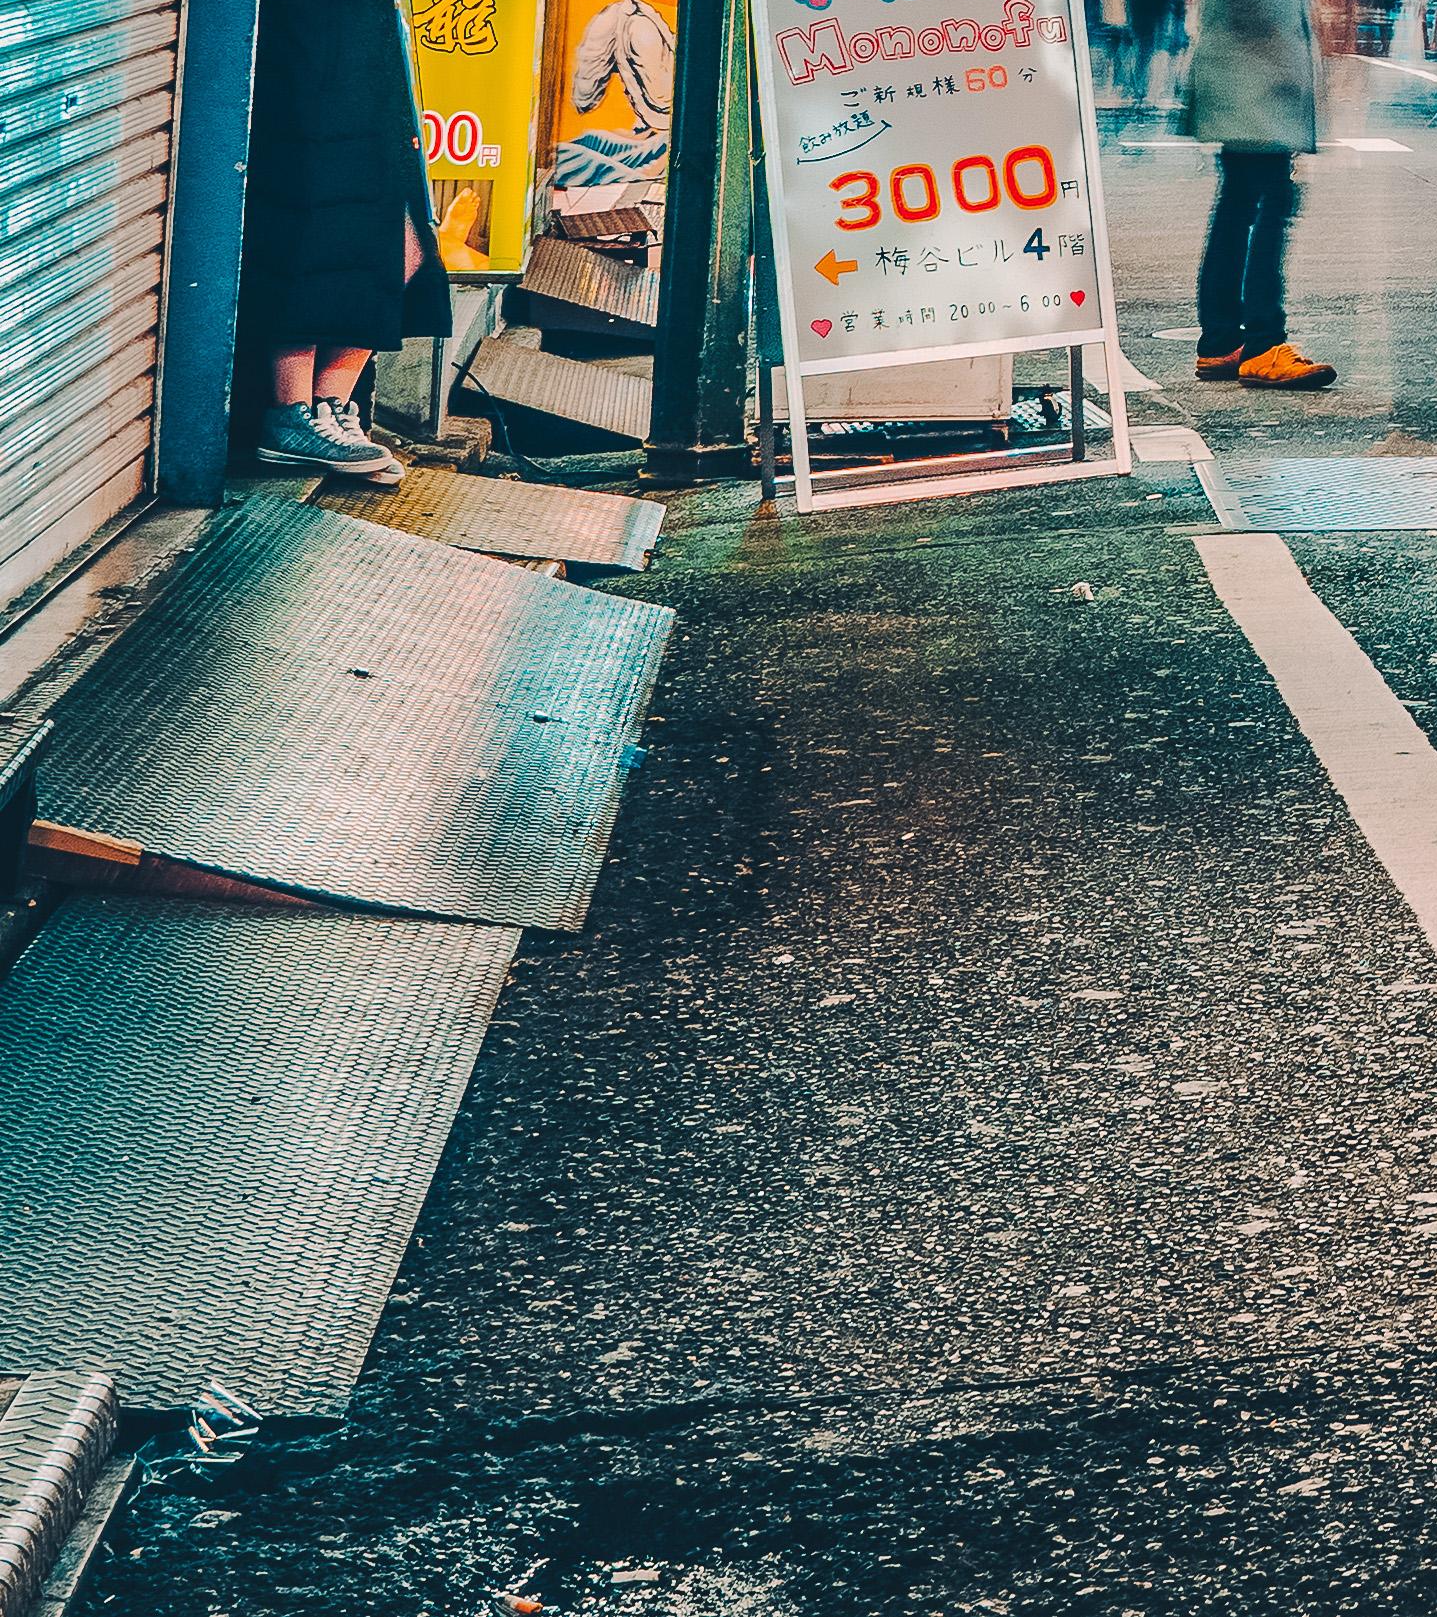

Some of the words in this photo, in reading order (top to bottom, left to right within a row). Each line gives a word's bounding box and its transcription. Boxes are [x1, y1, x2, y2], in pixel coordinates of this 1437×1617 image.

[797, 108, 876, 155] 飲み放題
[828, 143, 1080, 231] 3000円
[839, 306, 936, 334] 営業時間
